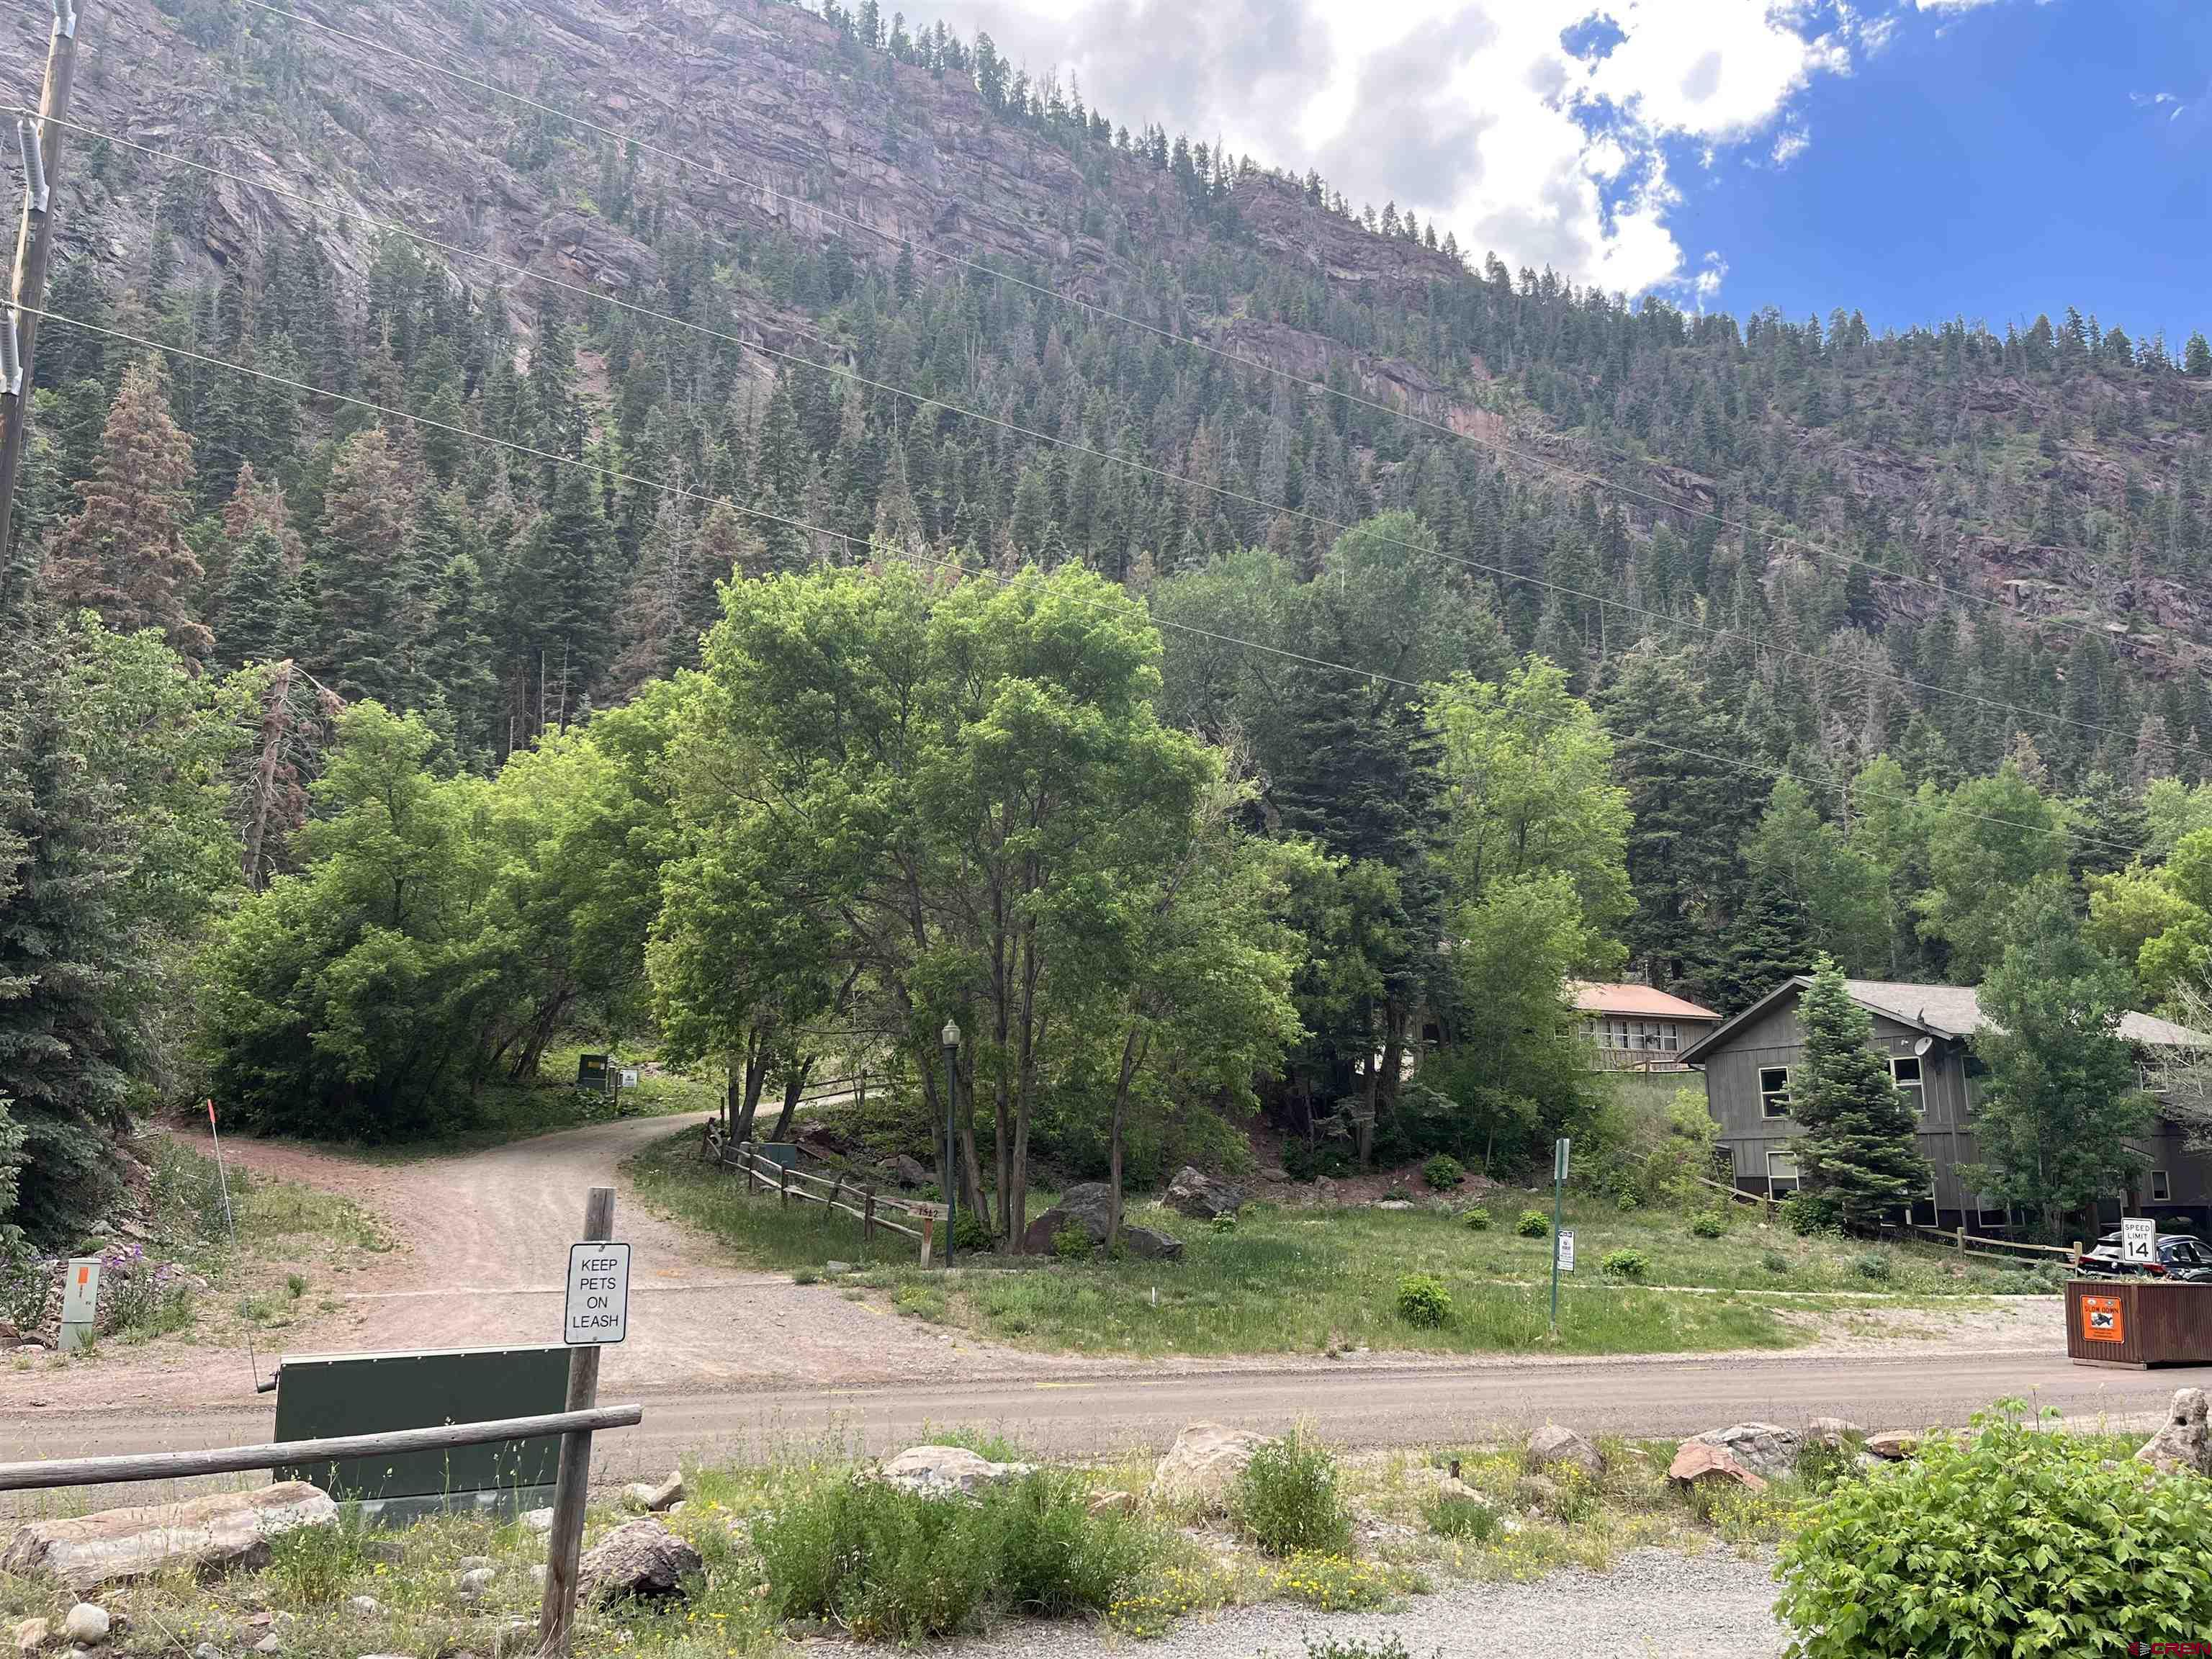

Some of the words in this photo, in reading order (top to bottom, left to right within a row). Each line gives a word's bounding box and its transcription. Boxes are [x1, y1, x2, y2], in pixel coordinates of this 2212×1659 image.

[919, 1208, 938, 1218] 1512
[2128, 1241, 2149, 1257] 14
[581, 1259, 618, 1271] KEEP
[580, 1277, 616, 1290] PETS
[587, 1297, 608, 1308] ON
[572, 1315, 619, 1328] LEASH
